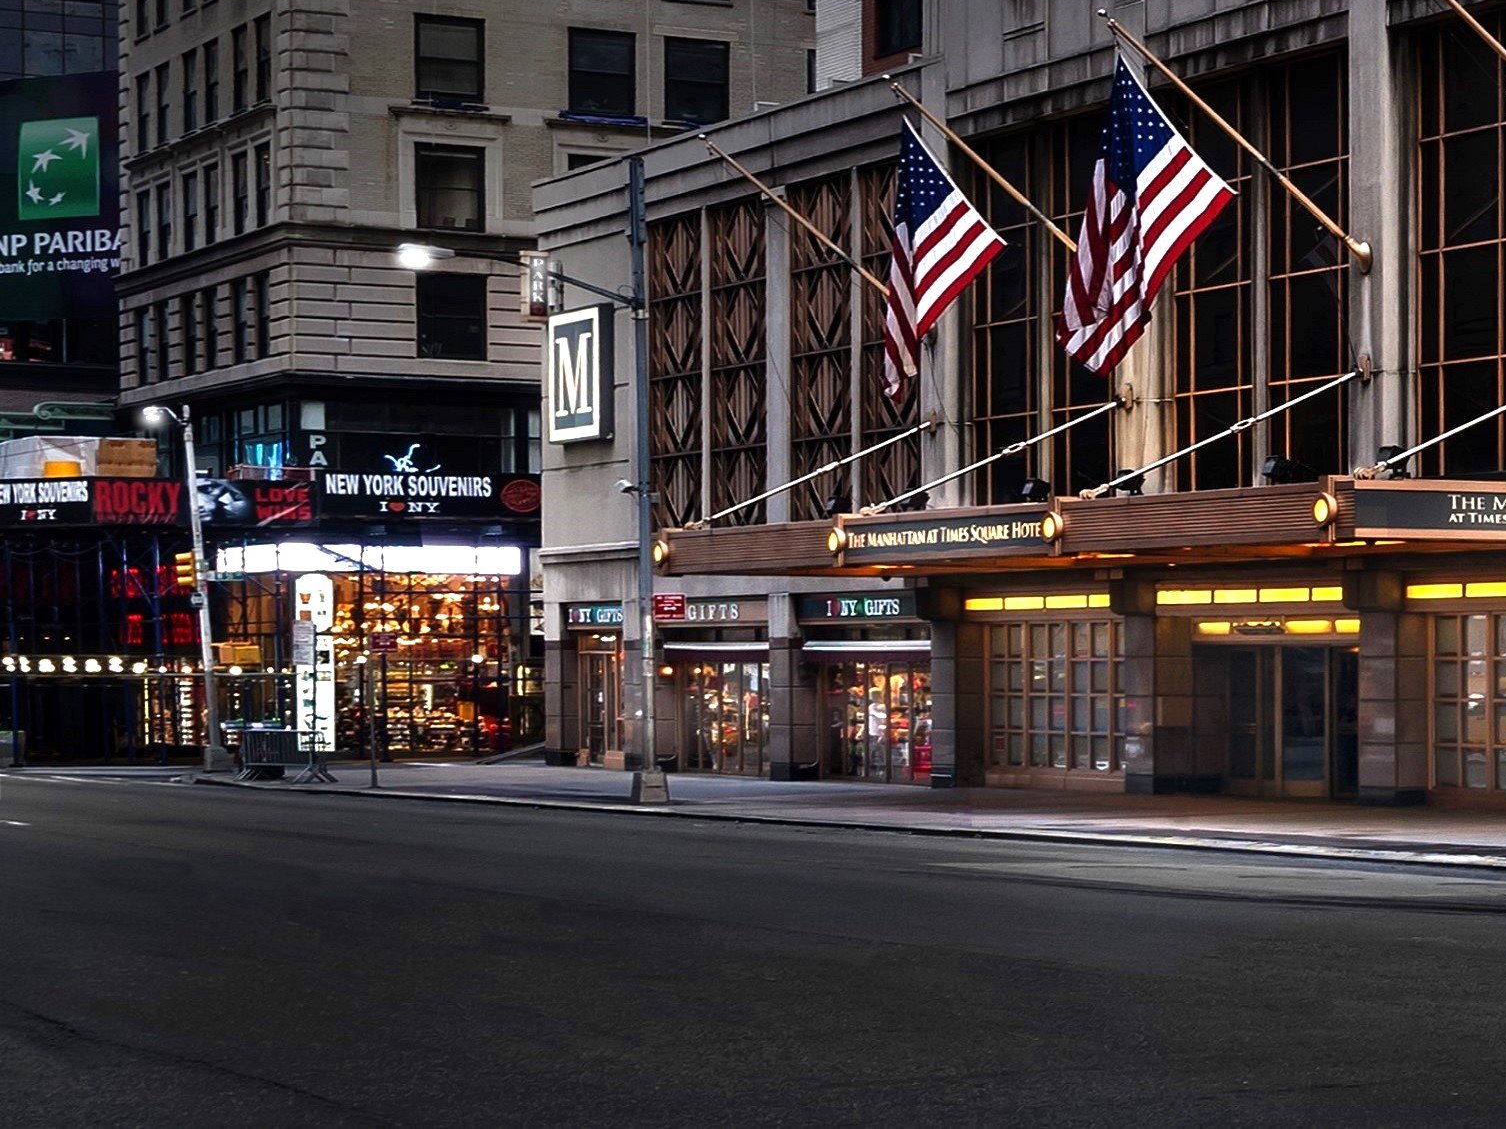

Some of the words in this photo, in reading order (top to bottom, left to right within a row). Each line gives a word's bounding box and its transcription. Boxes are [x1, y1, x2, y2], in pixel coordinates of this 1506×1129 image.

[27, 259, 45, 275] for
[47, 261, 54, 271] a
[57, 256, 108, 272] changing
[532, 258, 544, 302] PARK
[555, 332, 592, 417] M
[12, 483, 36, 504] YORK
[38, 480, 88, 503] SOUVENIRS
[255, 487, 310, 502] LOVE
[326, 473, 360, 495] NEW
[362, 474, 404, 496] YORK
[407, 476, 492, 498] SOUVENIRS
[94, 480, 181, 516] ROCKY
[1447, 494, 1486, 510] THE
[407, 502, 440, 513] NY
[1448, 513, 1466, 523] AT
[848, 532, 865, 548] THE
[867, 530, 926, 547] MANHATTAN
[926, 529, 939, 544] AT
[940, 526, 970, 542] TIMES
[970, 524, 1010, 544] SQUARE
[1012, 521, 1041, 539] HOTE
[597, 607, 624, 623] GIFTS
[687, 603, 739, 620] GIFTS
[840, 600, 858, 616] NY
[864, 598, 900, 616] GIFTS
